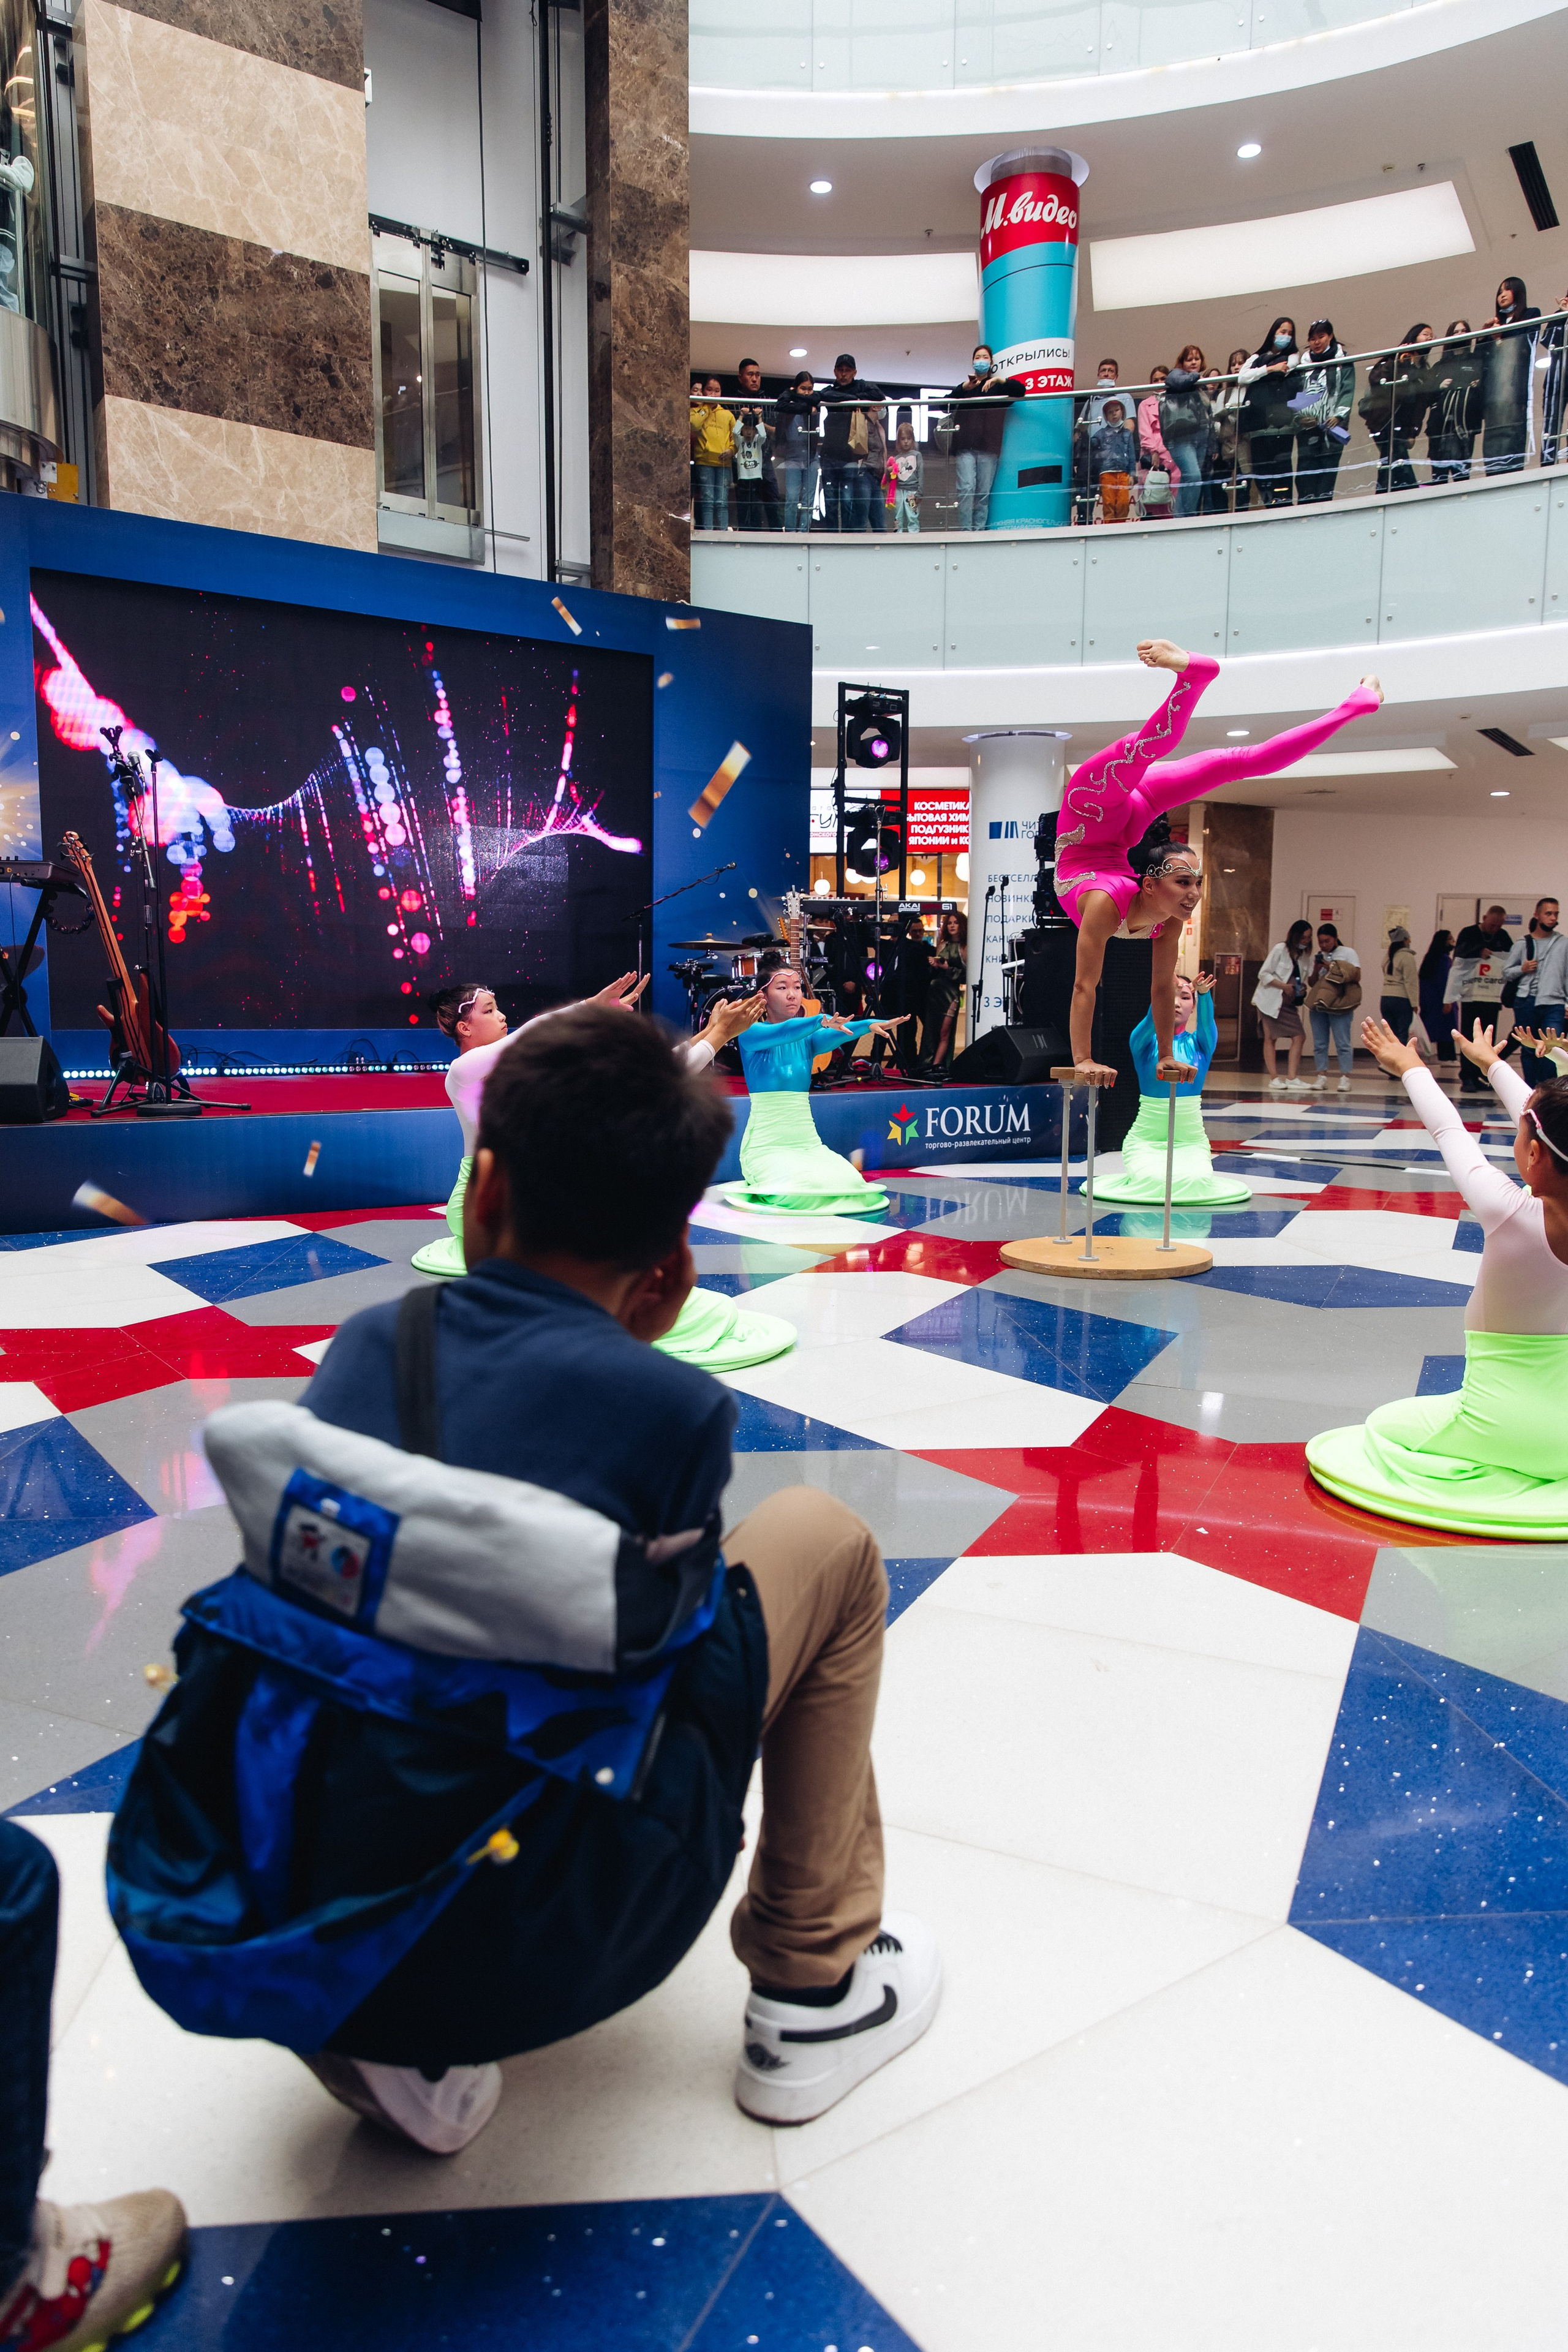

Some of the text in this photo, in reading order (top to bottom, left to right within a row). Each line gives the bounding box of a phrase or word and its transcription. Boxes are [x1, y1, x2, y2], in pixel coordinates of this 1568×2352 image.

[981, 191, 1077, 239] М.видео
[991, 349, 1071, 374] ОТКРЫЛИСЬ!
[1025, 375, 1073, 390] 3 ЭТАЖ
[908, 836, 949, 845] ЯПОНИИ
[984, 997, 990, 1008] 3
[925, 1103, 1031, 1137] FORUM
[925, 1136, 1031, 1150] торгово-развлекательный центр
